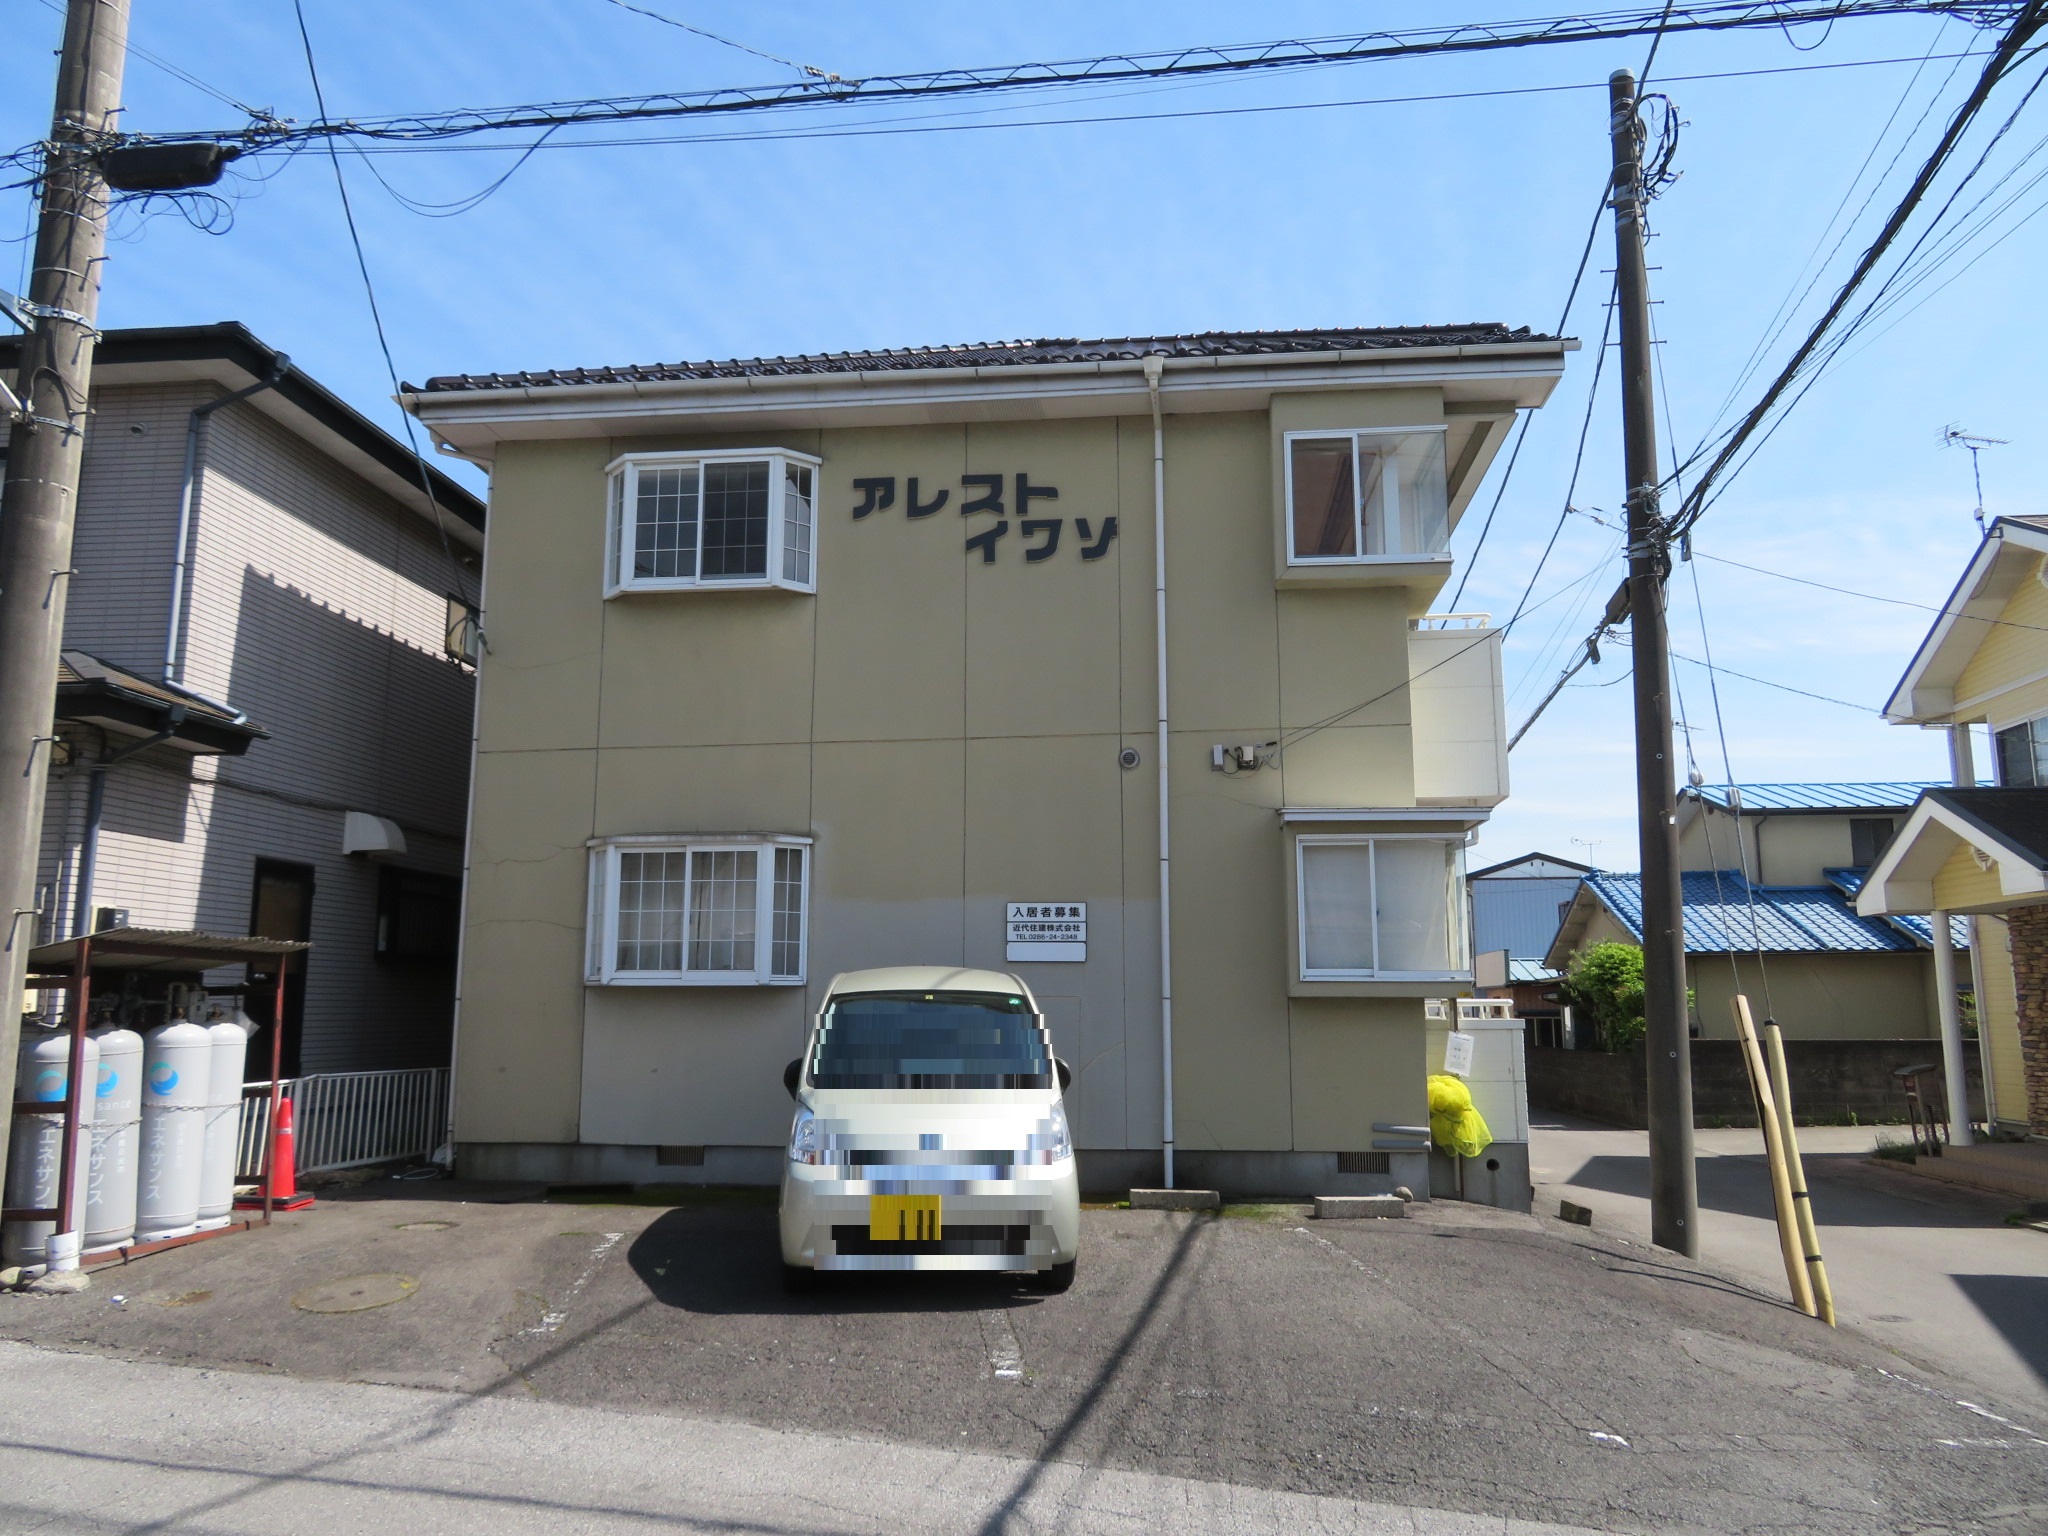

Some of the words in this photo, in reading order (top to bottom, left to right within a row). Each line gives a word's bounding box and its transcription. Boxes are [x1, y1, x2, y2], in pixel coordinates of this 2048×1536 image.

[853, 473, 1059, 521] アレスト
[1012, 906, 1081, 918] 入居者募集
[1012, 923, 1081, 932] 近代住建株式会社
[88, 1118, 107, 1205] エネサンス
[145, 1117, 167, 1200] エネサンス
